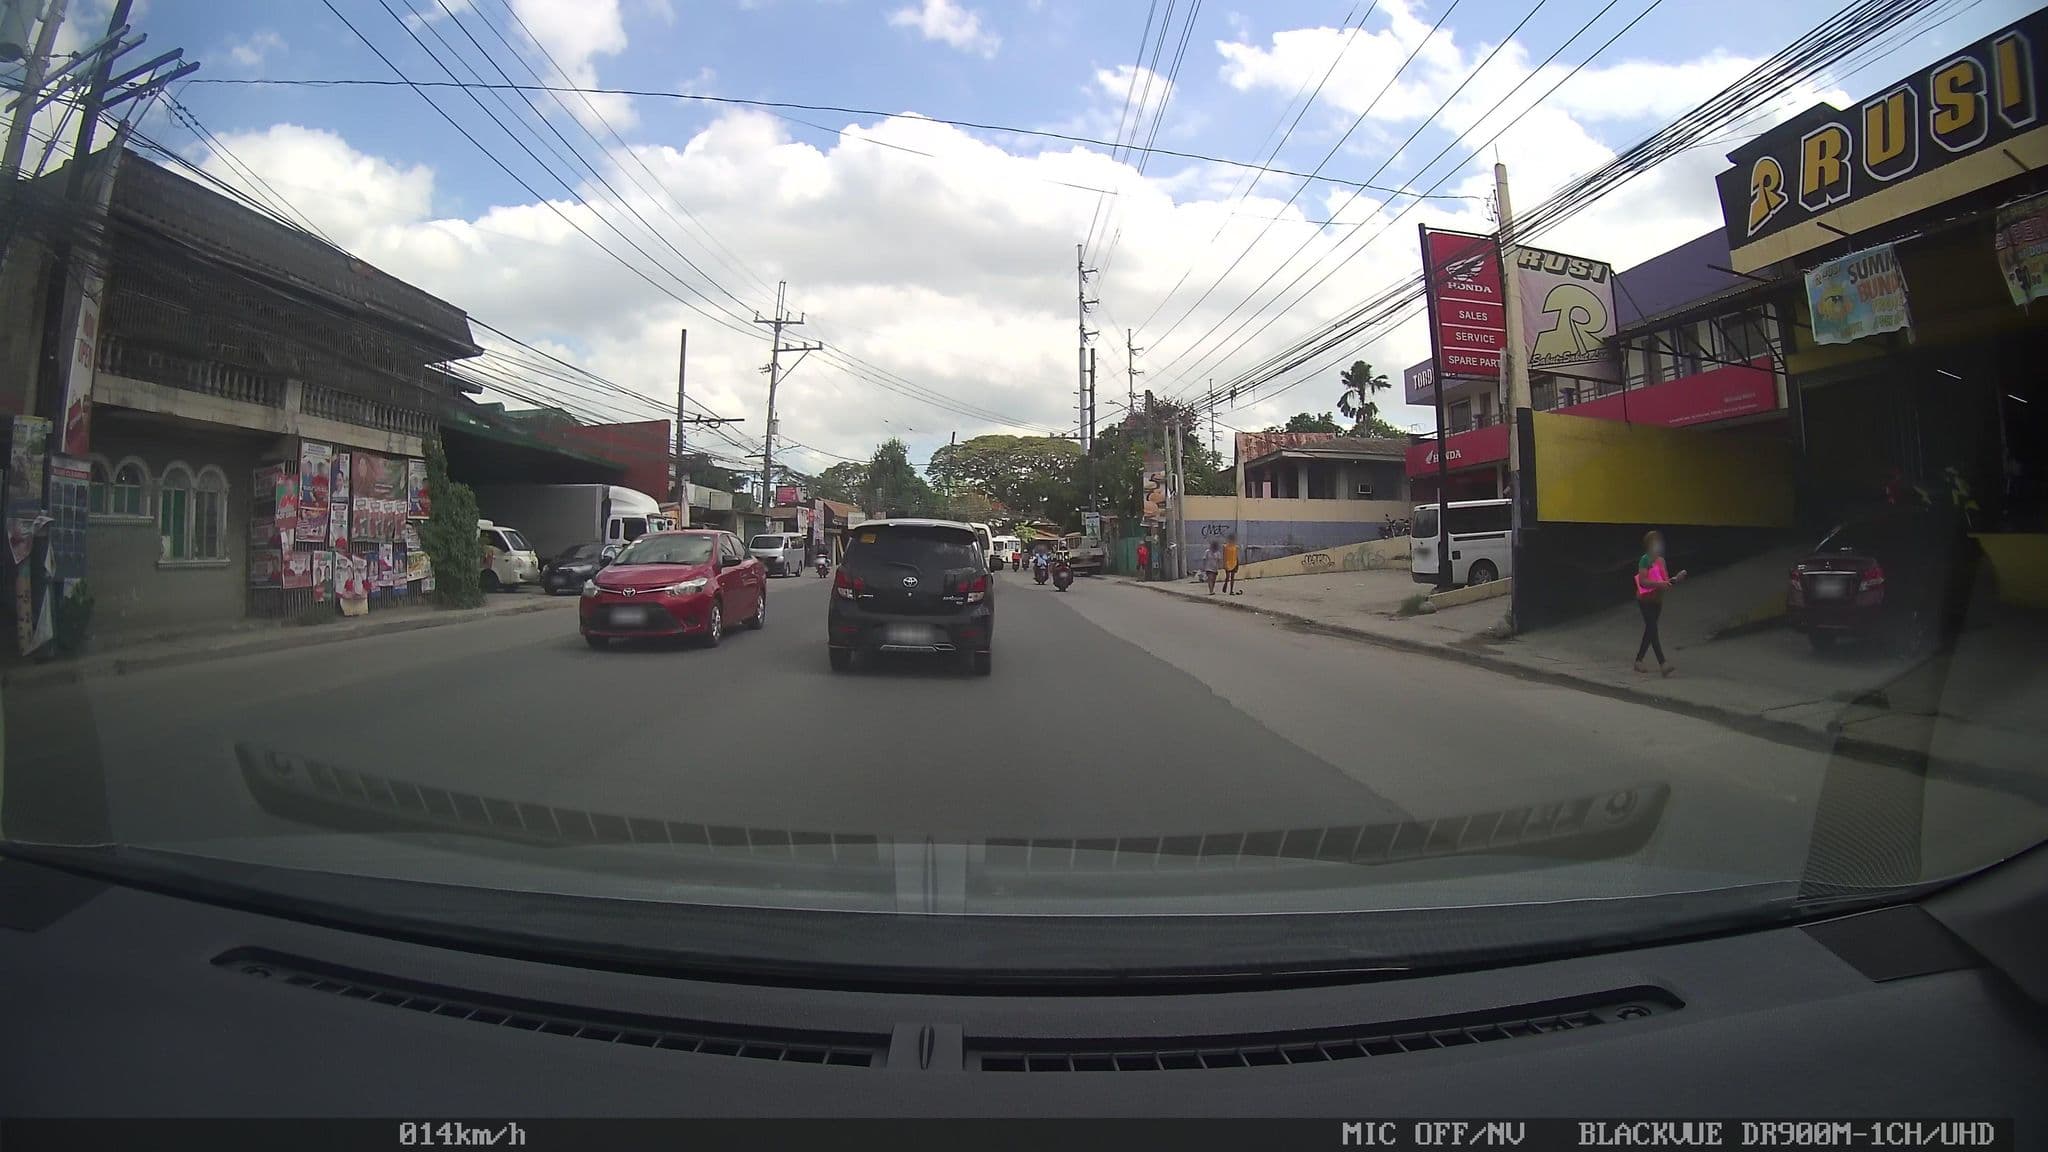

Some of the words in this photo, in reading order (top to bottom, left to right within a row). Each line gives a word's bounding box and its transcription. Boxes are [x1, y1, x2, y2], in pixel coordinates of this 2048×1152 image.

[1799, 31, 2036, 212] RUSI
[1517, 248, 1608, 284] RUSI
[1447, 281, 1493, 294] HONDA
[1458, 310, 1488, 321] SALES
[1455, 332, 1495, 344] SERVICE
[1448, 355, 1478, 366] SPARE
[1433, 450, 1462, 463] HNDA
